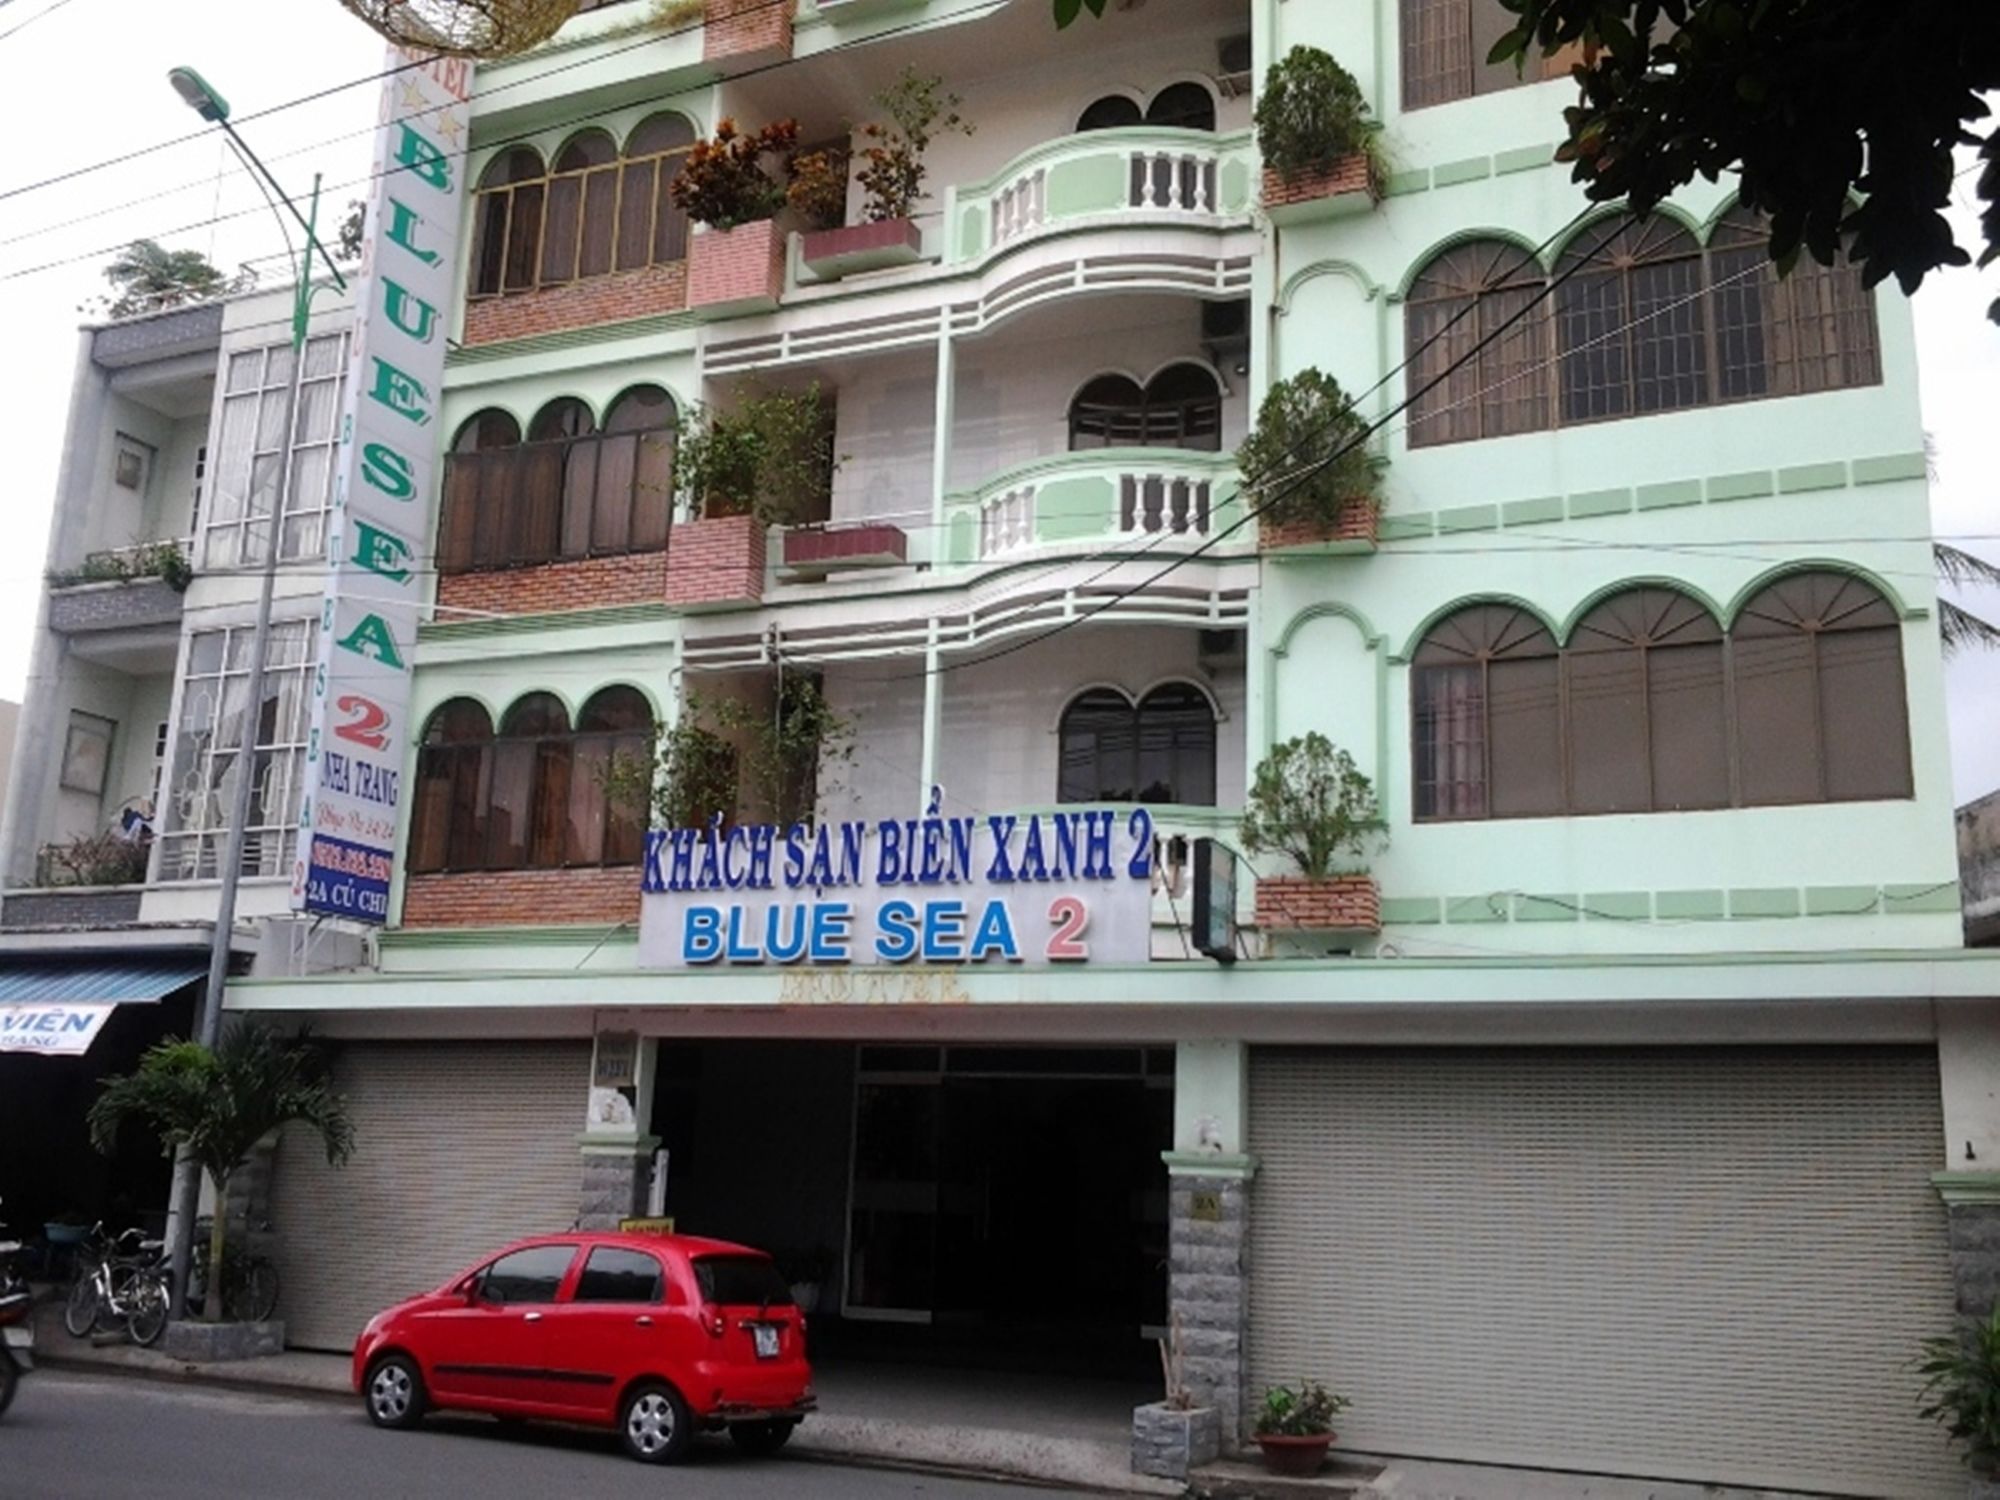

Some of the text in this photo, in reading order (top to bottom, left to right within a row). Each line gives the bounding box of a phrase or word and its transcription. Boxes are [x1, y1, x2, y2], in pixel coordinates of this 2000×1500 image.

[333, 695, 392, 752] 2
[321, 750, 398, 806] NHA TRANG
[641, 785, 1151, 898] KHÁCH SẠN BIỂN XANH 2
[308, 879, 327, 903] 2A
[358, 889, 388, 915] CHI
[682, 896, 1087, 962] BLUE SEA 2
